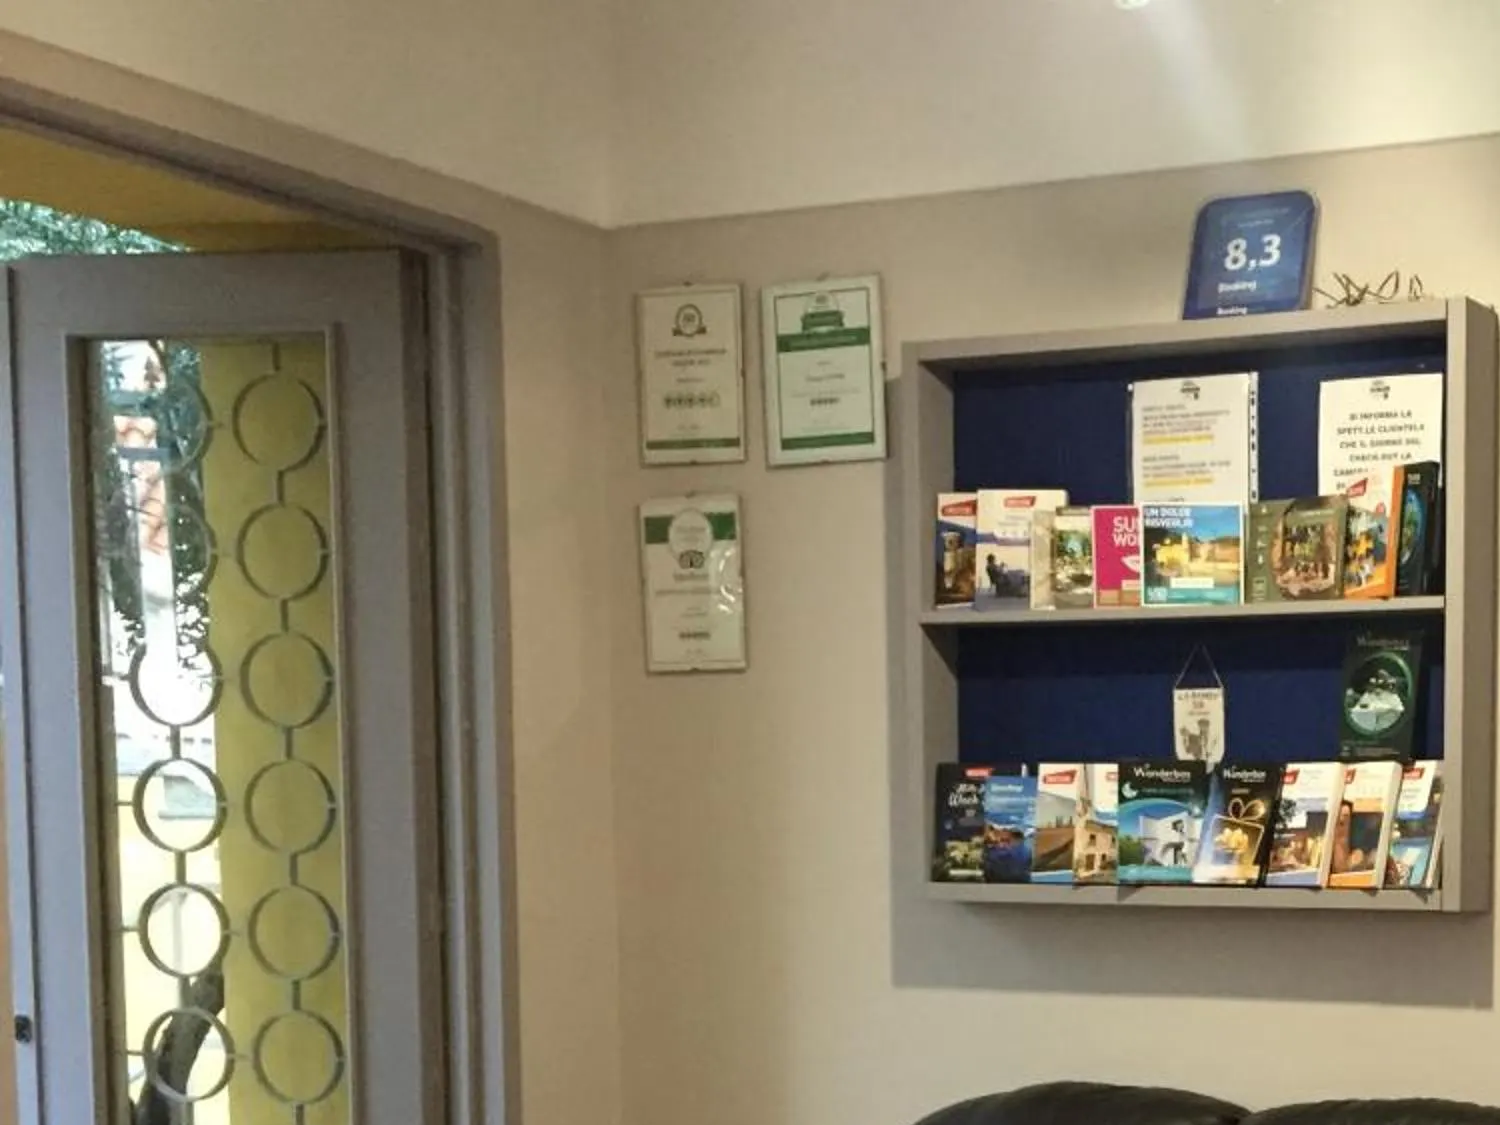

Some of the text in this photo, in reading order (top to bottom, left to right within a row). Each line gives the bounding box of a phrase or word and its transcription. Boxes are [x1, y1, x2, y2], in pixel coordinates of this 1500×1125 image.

[1223, 233, 1282, 272] 8,3
[1359, 411, 1398, 420] INFORMA
[1401, 409, 1412, 418] LA
[1339, 440, 1357, 449] CHE
